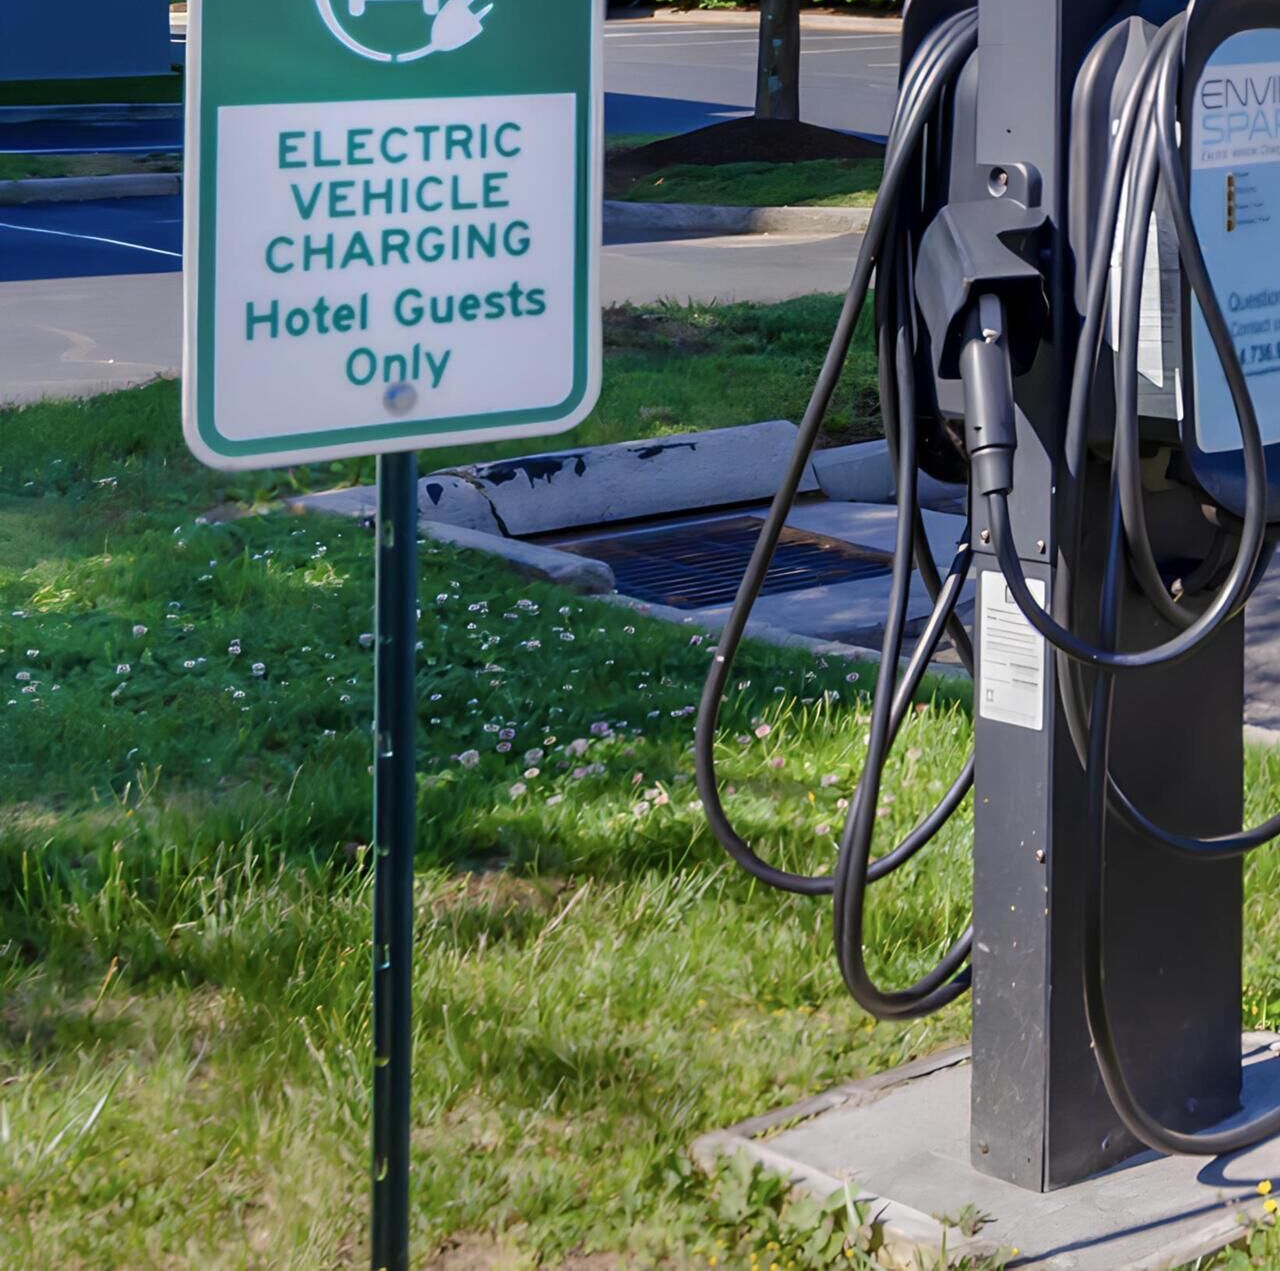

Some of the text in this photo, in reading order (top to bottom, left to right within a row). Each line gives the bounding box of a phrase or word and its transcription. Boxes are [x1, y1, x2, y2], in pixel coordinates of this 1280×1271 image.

[279, 122, 521, 169] ELECTRIC
[291, 172, 509, 220] VEHICLE
[265, 220, 530, 274] CHARGING
[246, 281, 546, 341] Hotel Guests
[346, 343, 451, 388] Only
